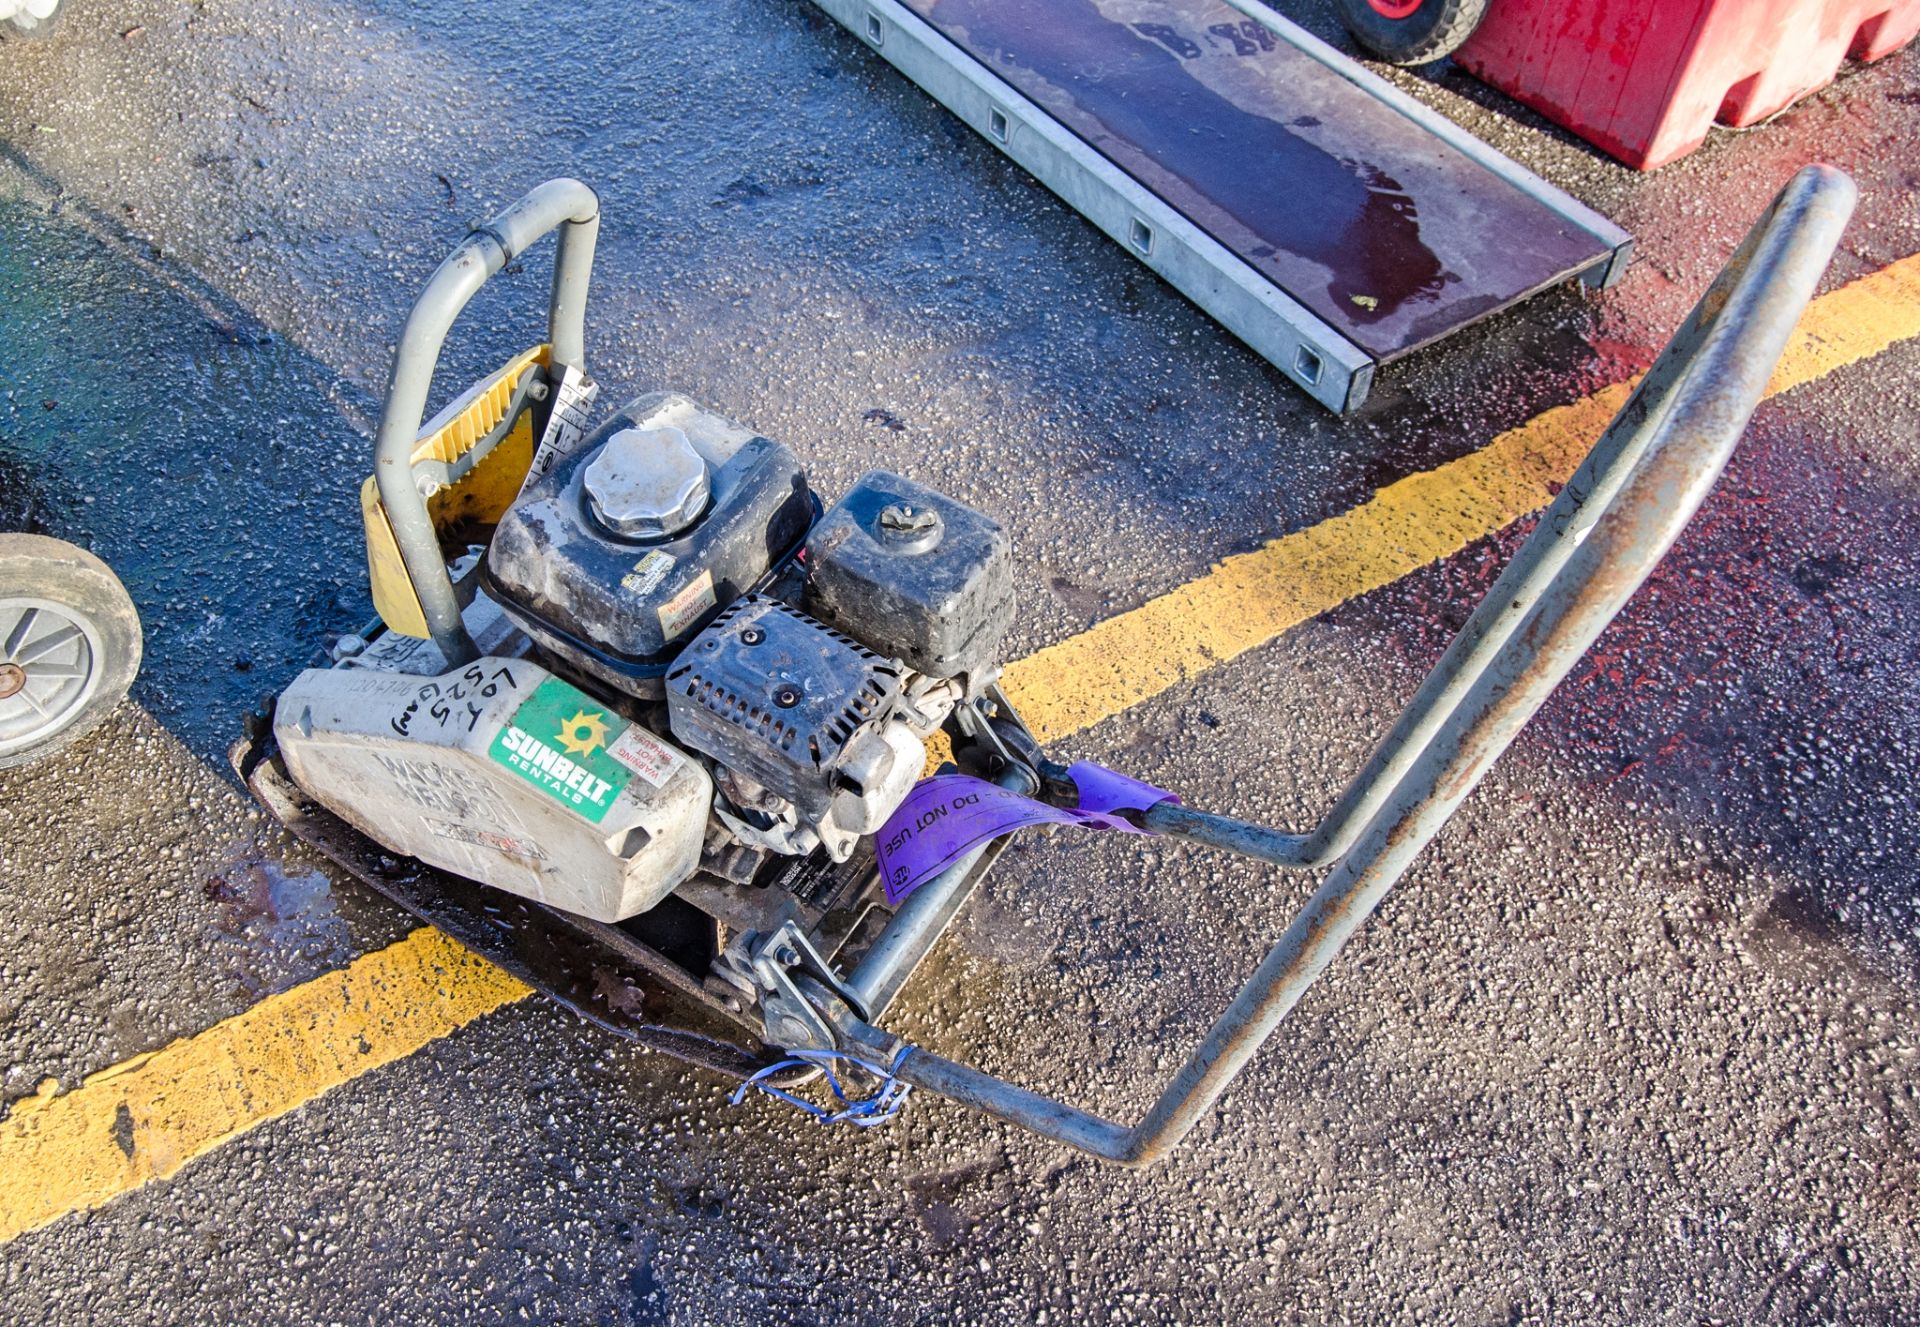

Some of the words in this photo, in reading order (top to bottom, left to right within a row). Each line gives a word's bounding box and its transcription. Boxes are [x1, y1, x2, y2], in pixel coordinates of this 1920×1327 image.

[673, 598, 708, 631] EXHAUST
[431, 665, 484, 727] 525
[458, 665, 517, 733] LOT
[501, 726, 612, 805] SUNBELT
[617, 748, 659, 779] WARNING
[635, 748, 657, 764] HOT
[509, 754, 583, 805] RENTALS
[918, 803, 948, 832] NOT
[953, 794, 979, 810] DO
[885, 827, 912, 857] USE
